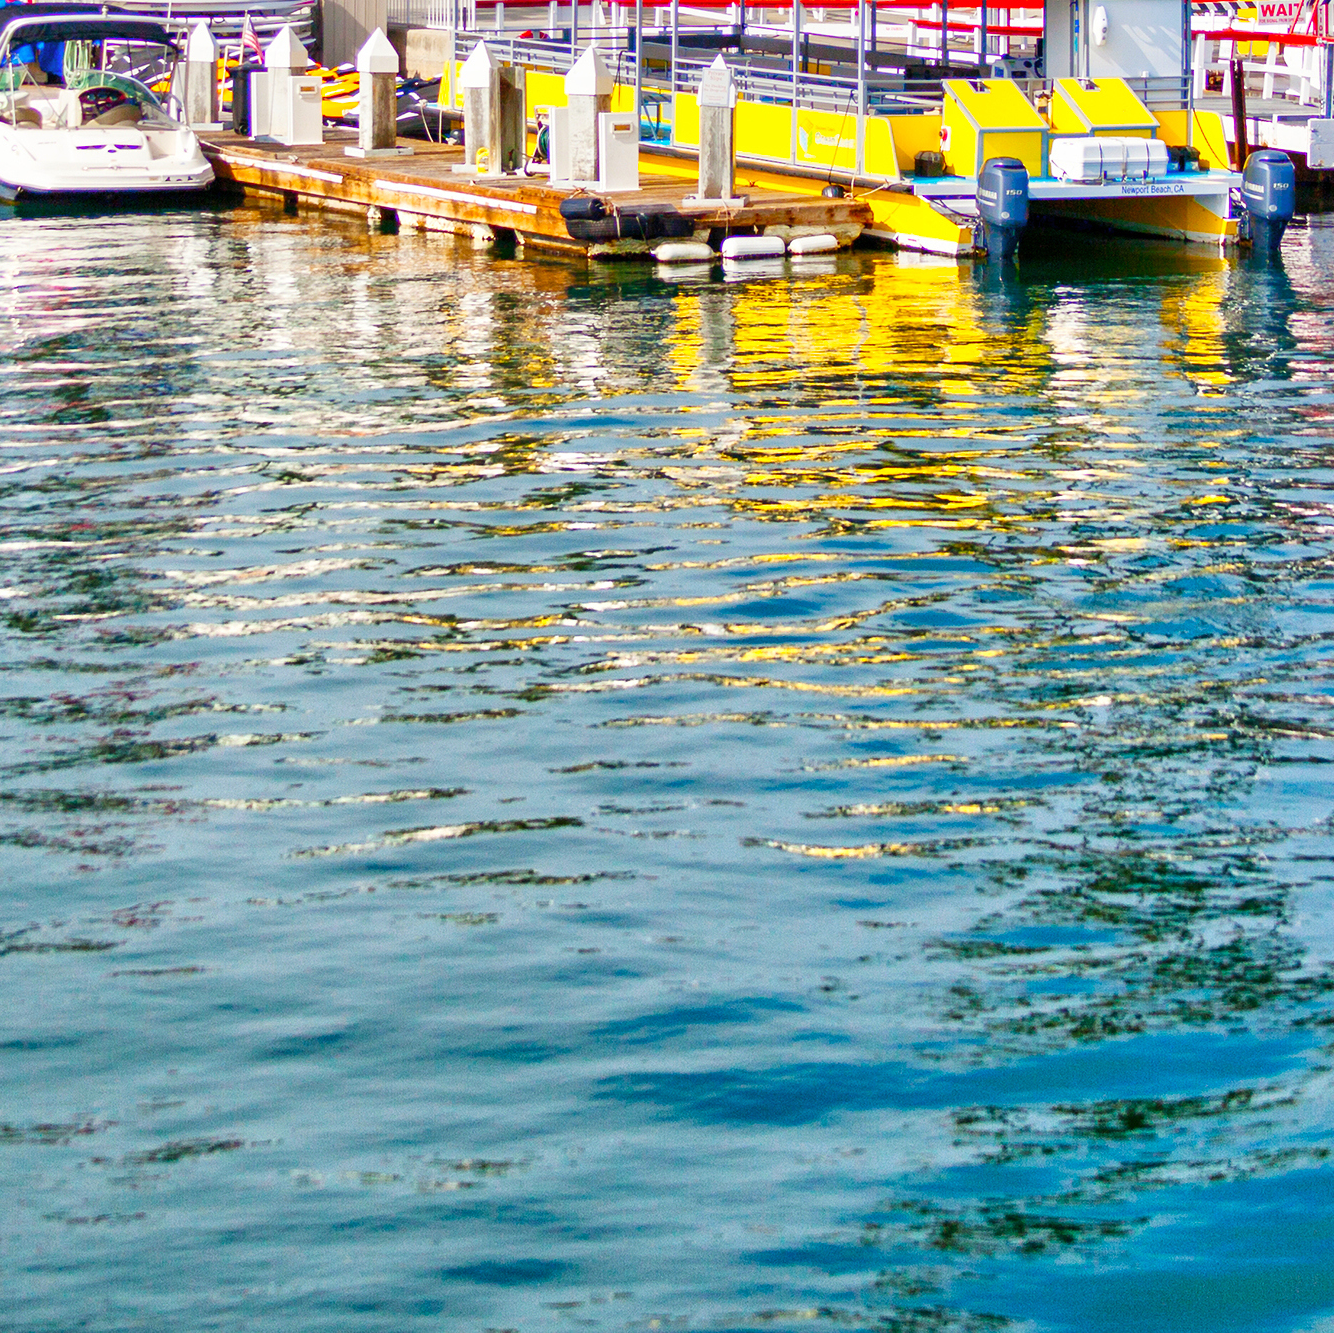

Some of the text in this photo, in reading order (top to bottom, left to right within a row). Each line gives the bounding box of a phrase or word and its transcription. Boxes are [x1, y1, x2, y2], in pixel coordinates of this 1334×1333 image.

[1121, 184, 1184, 195] Newport Beach, CA
